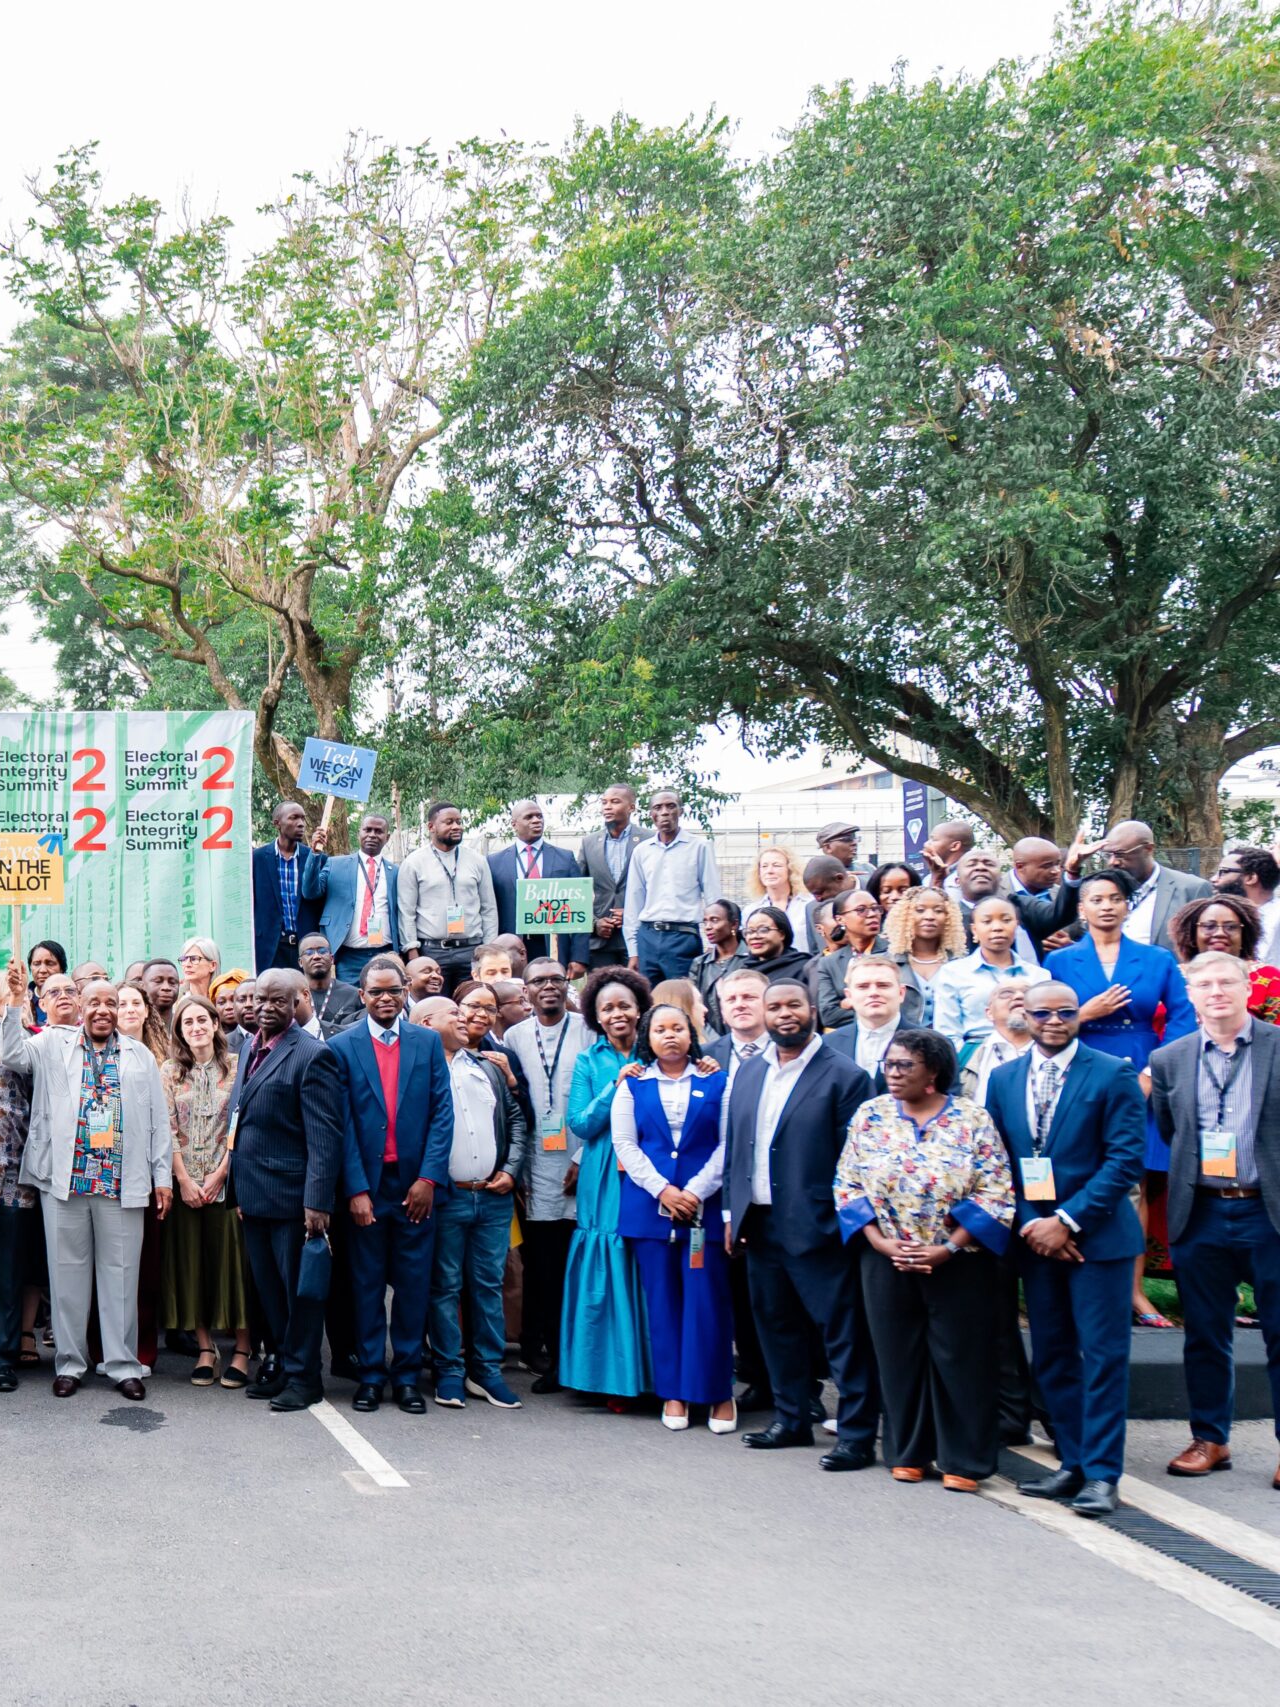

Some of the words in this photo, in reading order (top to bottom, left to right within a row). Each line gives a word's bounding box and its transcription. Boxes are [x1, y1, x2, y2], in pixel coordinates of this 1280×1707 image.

[124, 750, 198, 762] Electoral
[324, 746, 359, 768] Tech
[72, 748, 106, 792] 2
[124, 764, 198, 780] Integrity
[202, 746, 235, 790] 2
[310, 757, 332, 773] WE
[333, 763, 363, 779] CAN
[124, 779, 189, 791] Summit
[314, 770, 358, 789] TRUST
[125, 810, 199, 822] Electoral
[73, 807, 107, 851] 2
[125, 824, 198, 839] Integrity
[202, 806, 233, 850] 2
[125, 838, 189, 851] Summit
[16, 859, 50, 874] THE
[539, 899, 569, 911] NOT
[524, 911, 586, 924] BULLETS
